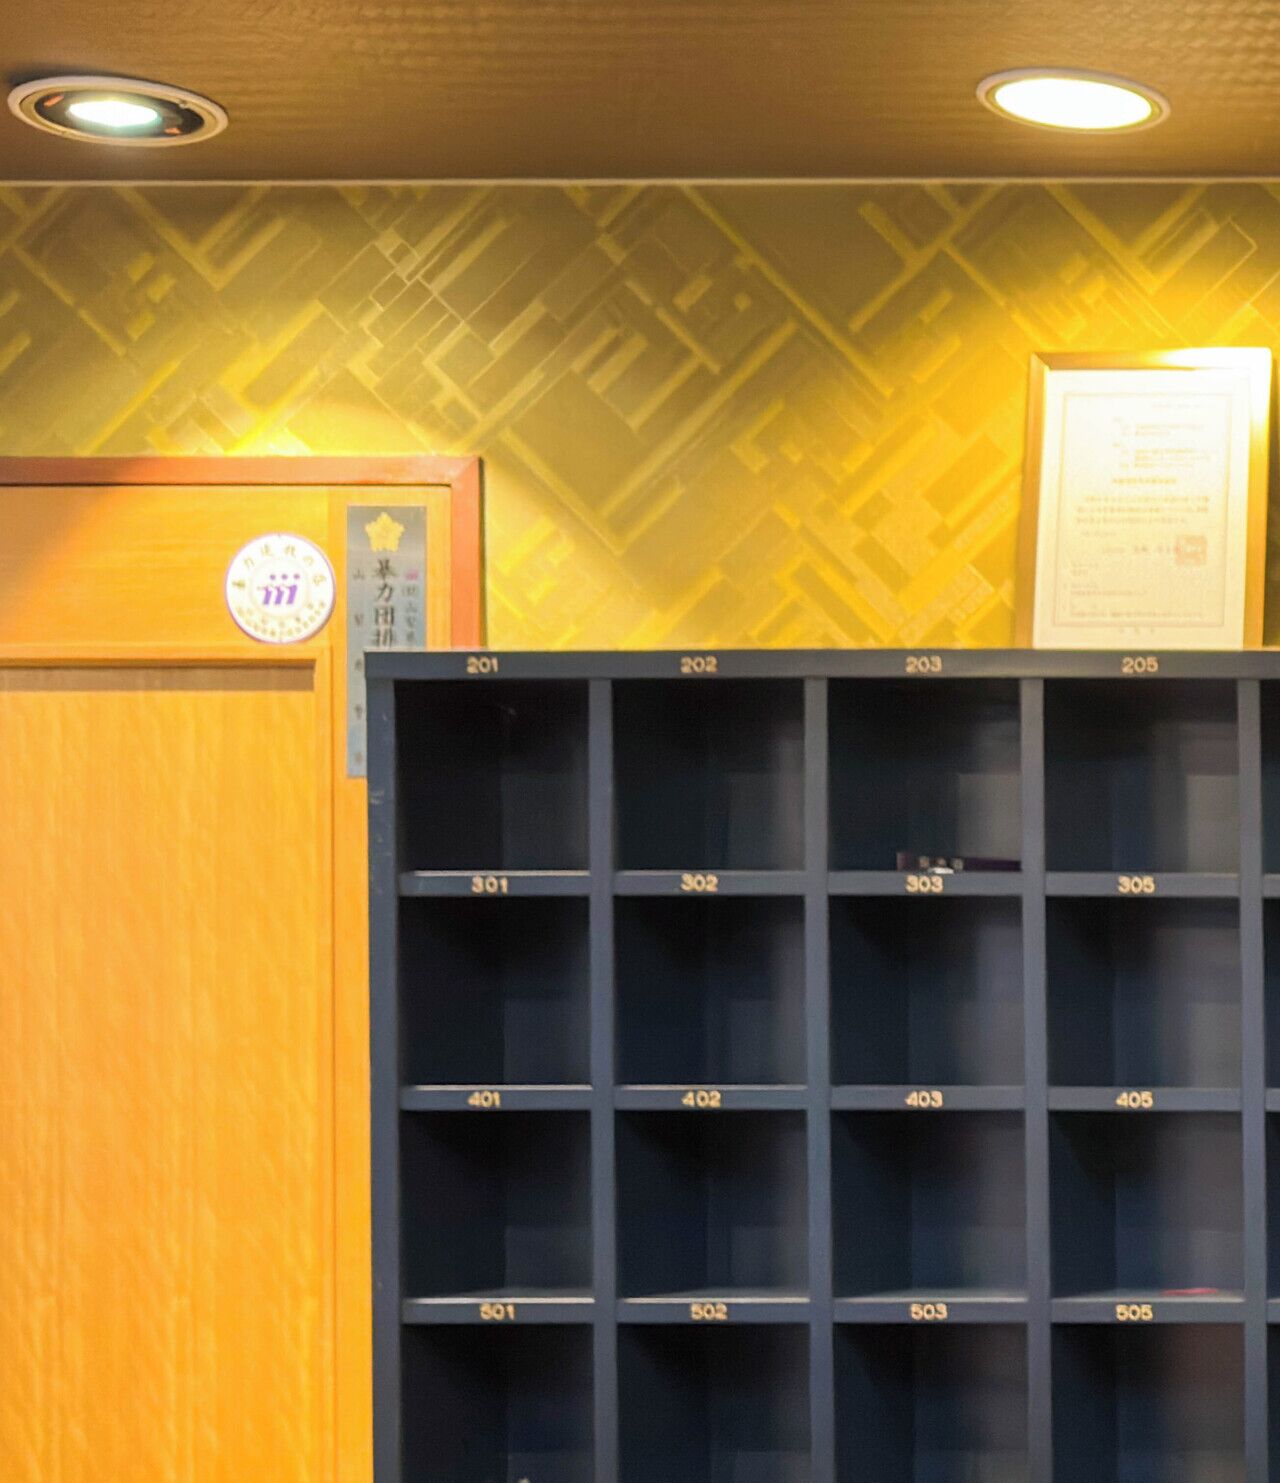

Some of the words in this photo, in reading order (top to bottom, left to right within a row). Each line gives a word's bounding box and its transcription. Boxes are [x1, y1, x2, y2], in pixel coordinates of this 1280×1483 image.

[466, 656, 499, 675] 201
[680, 655, 718, 674] 202
[905, 655, 943, 674] 203
[1120, 655, 1159, 674] 205
[472, 873, 509, 894] 301
[681, 872, 719, 893] 302
[905, 873, 945, 894] 303
[1118, 875, 1157, 895] 305
[467, 1088, 501, 1108] 401
[681, 1089, 722, 1109] 402
[905, 1089, 944, 1109] 403
[1114, 1090, 1154, 1110] 405
[479, 1302, 517, 1322] 501
[690, 1303, 728, 1322] 502
[910, 1301, 949, 1321] 503
[1115, 1303, 1154, 1322] 505
